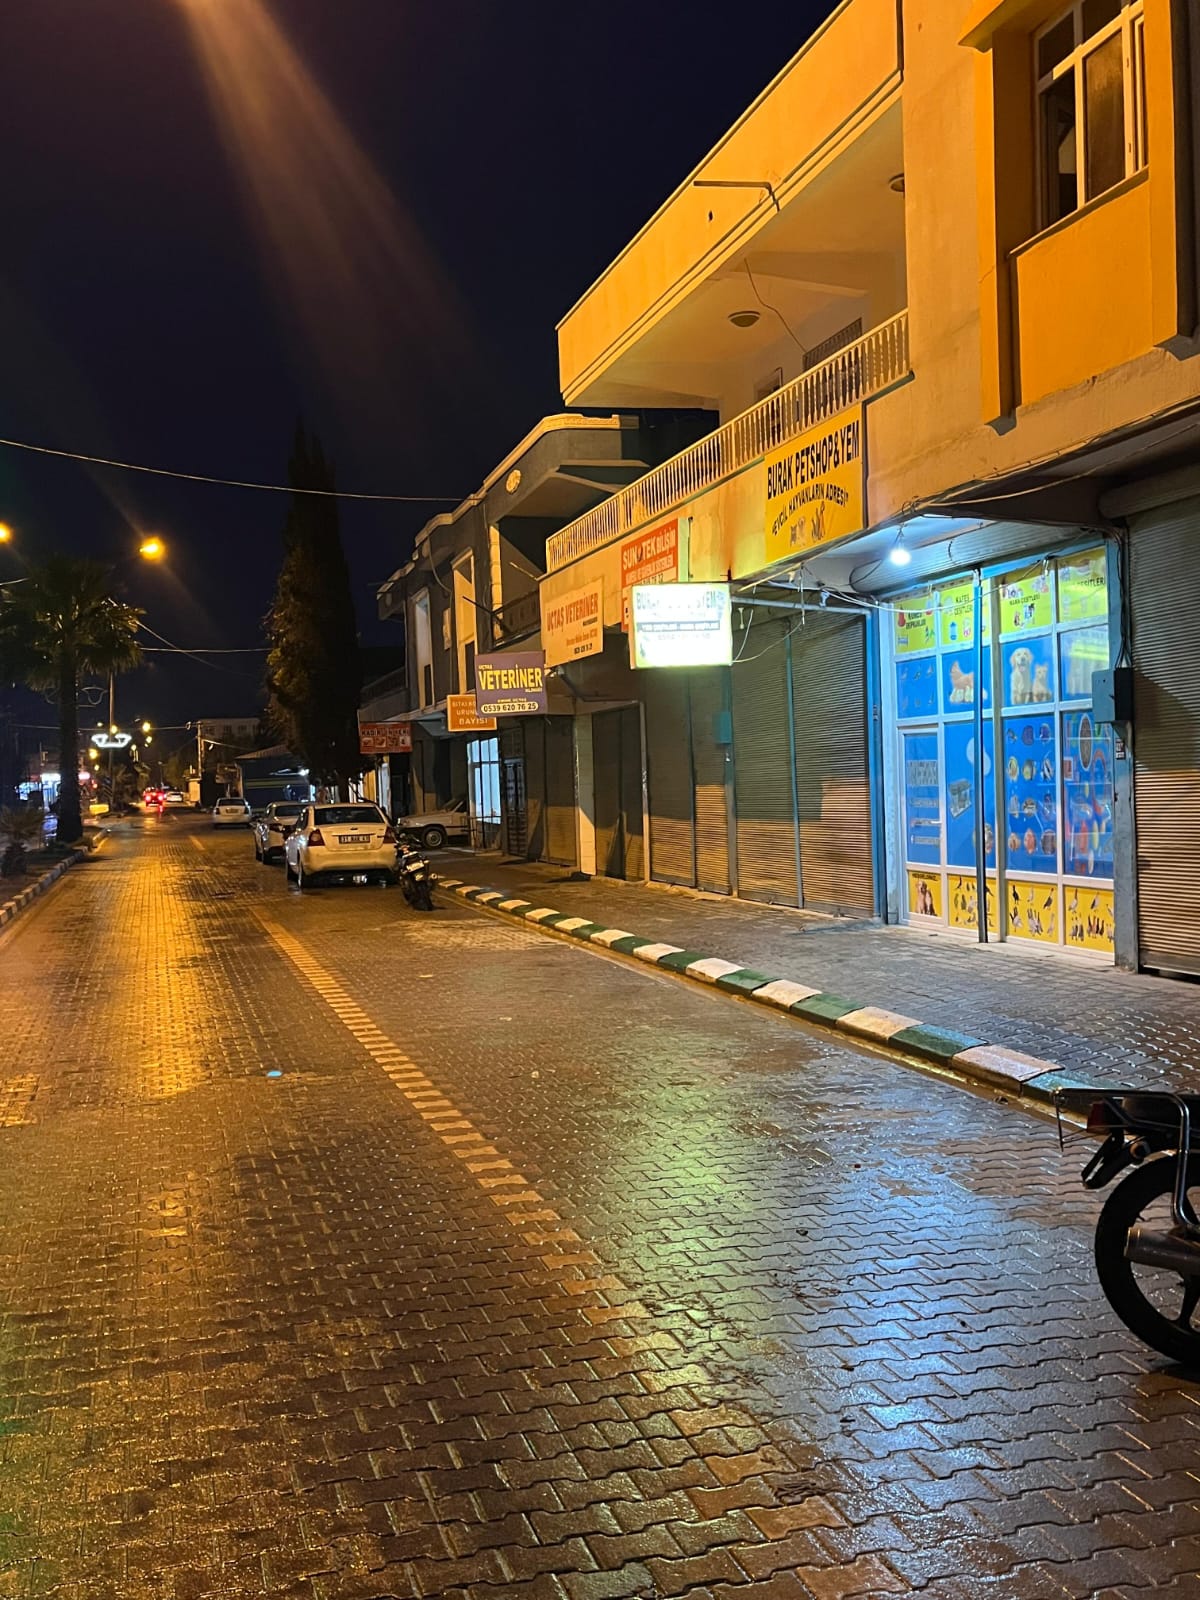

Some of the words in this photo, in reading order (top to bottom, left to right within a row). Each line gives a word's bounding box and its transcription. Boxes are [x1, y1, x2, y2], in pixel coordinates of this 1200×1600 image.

[767, 455, 793, 500] BURAK
[546, 606, 564, 636] UÇTAŞ
[565, 592, 599, 625] VETERİNER
[478, 664, 543, 691] VETERİNER
[483, 704, 501, 713] 0539
[502, 704, 516, 712] 620
[518, 703, 526, 711] 76
[528, 702, 537, 710] 25
